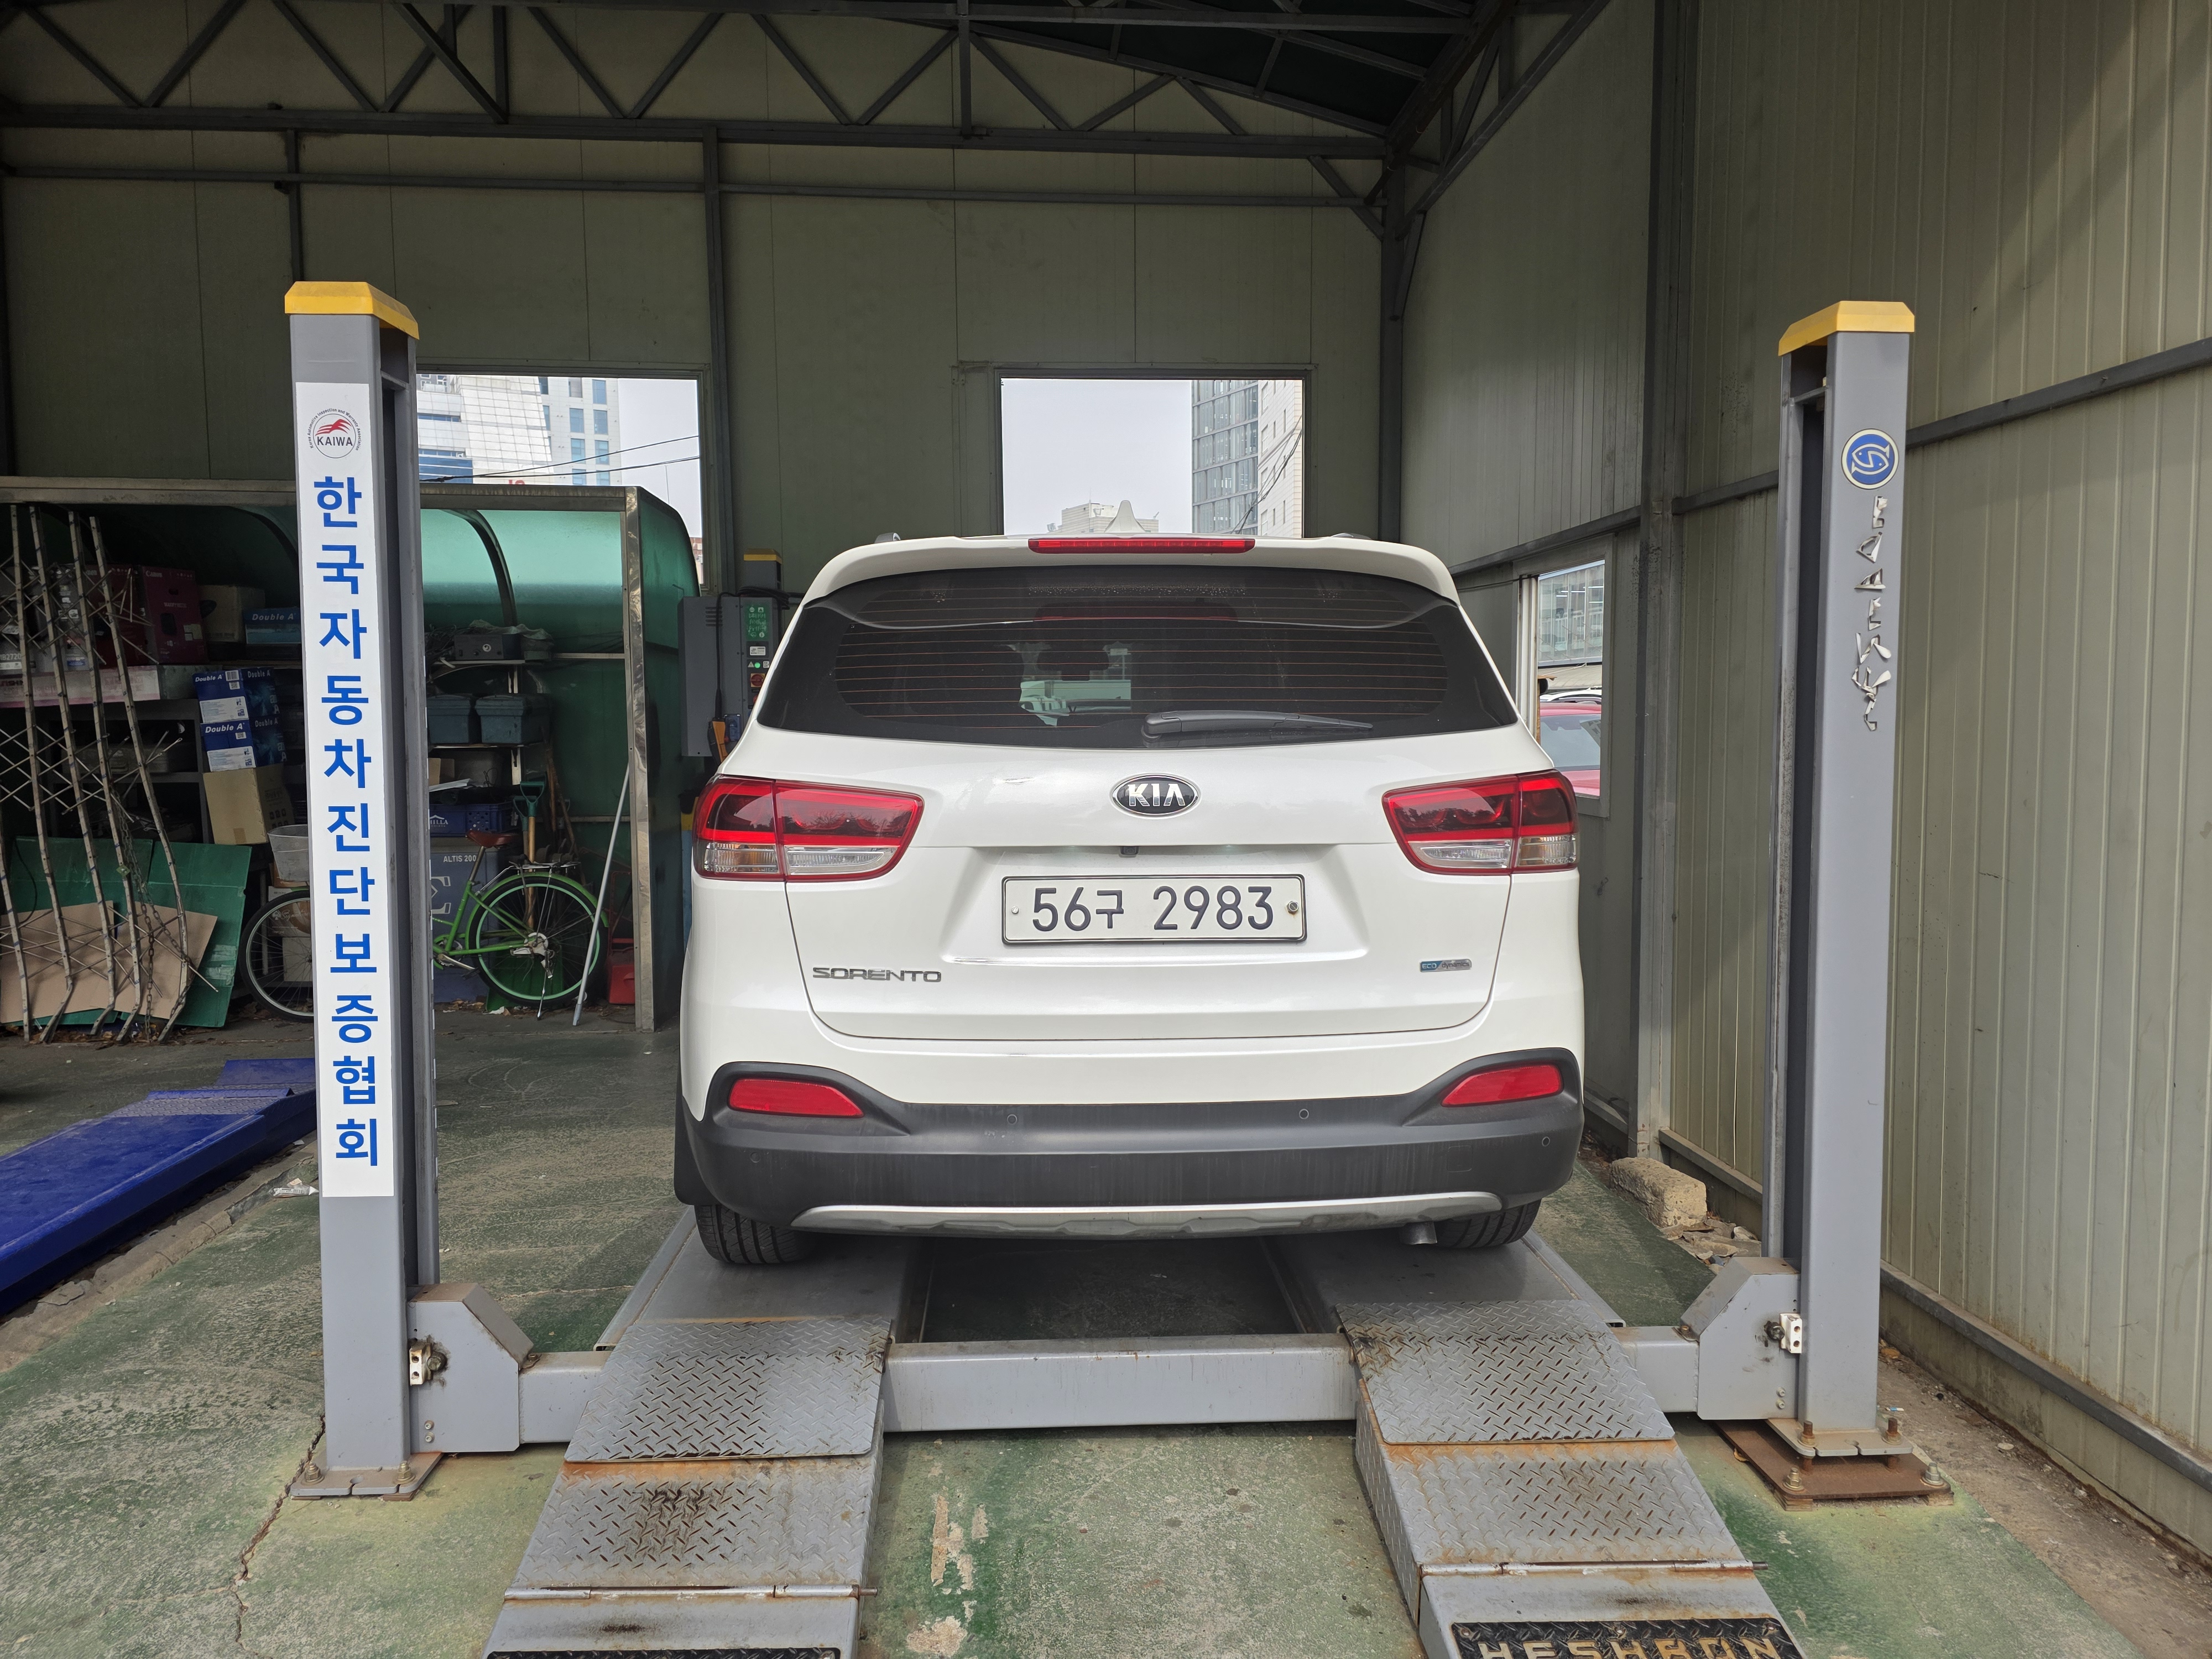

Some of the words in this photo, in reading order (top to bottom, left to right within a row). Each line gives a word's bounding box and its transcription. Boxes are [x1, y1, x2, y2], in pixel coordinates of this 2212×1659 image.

[317, 408, 337, 416] Inspection
[346, 411, 359, 427] Warranty
[317, 436, 353, 446] KAIWA
[195, 674, 216, 682] Double
[247, 670, 265, 678] Double
[205, 724, 234, 733] Double
[255, 719, 273, 727] Double
[1127, 783, 1186, 807] KIA
[315, 477, 378, 1166] 한국자동차진단보증협회
[1032, 886, 1124, 932] 56구
[1153, 885, 1274, 930] 2983
[812, 967, 942, 983] SORENTO
